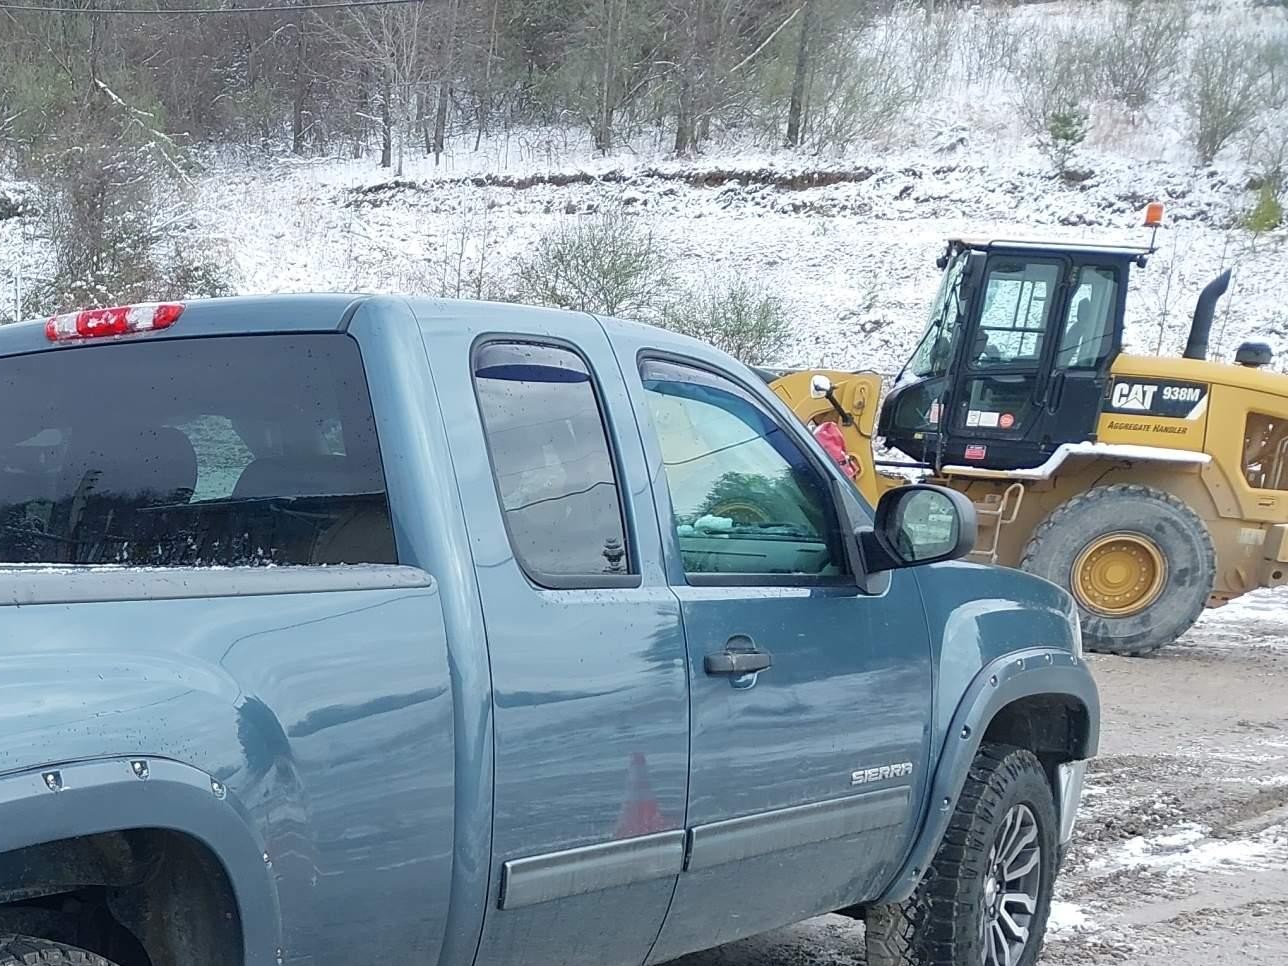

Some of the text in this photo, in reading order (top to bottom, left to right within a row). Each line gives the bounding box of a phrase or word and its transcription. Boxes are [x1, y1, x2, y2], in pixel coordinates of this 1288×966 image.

[1112, 383, 1201, 410] CAT 938M
[851, 762, 913, 785] SIERRA
